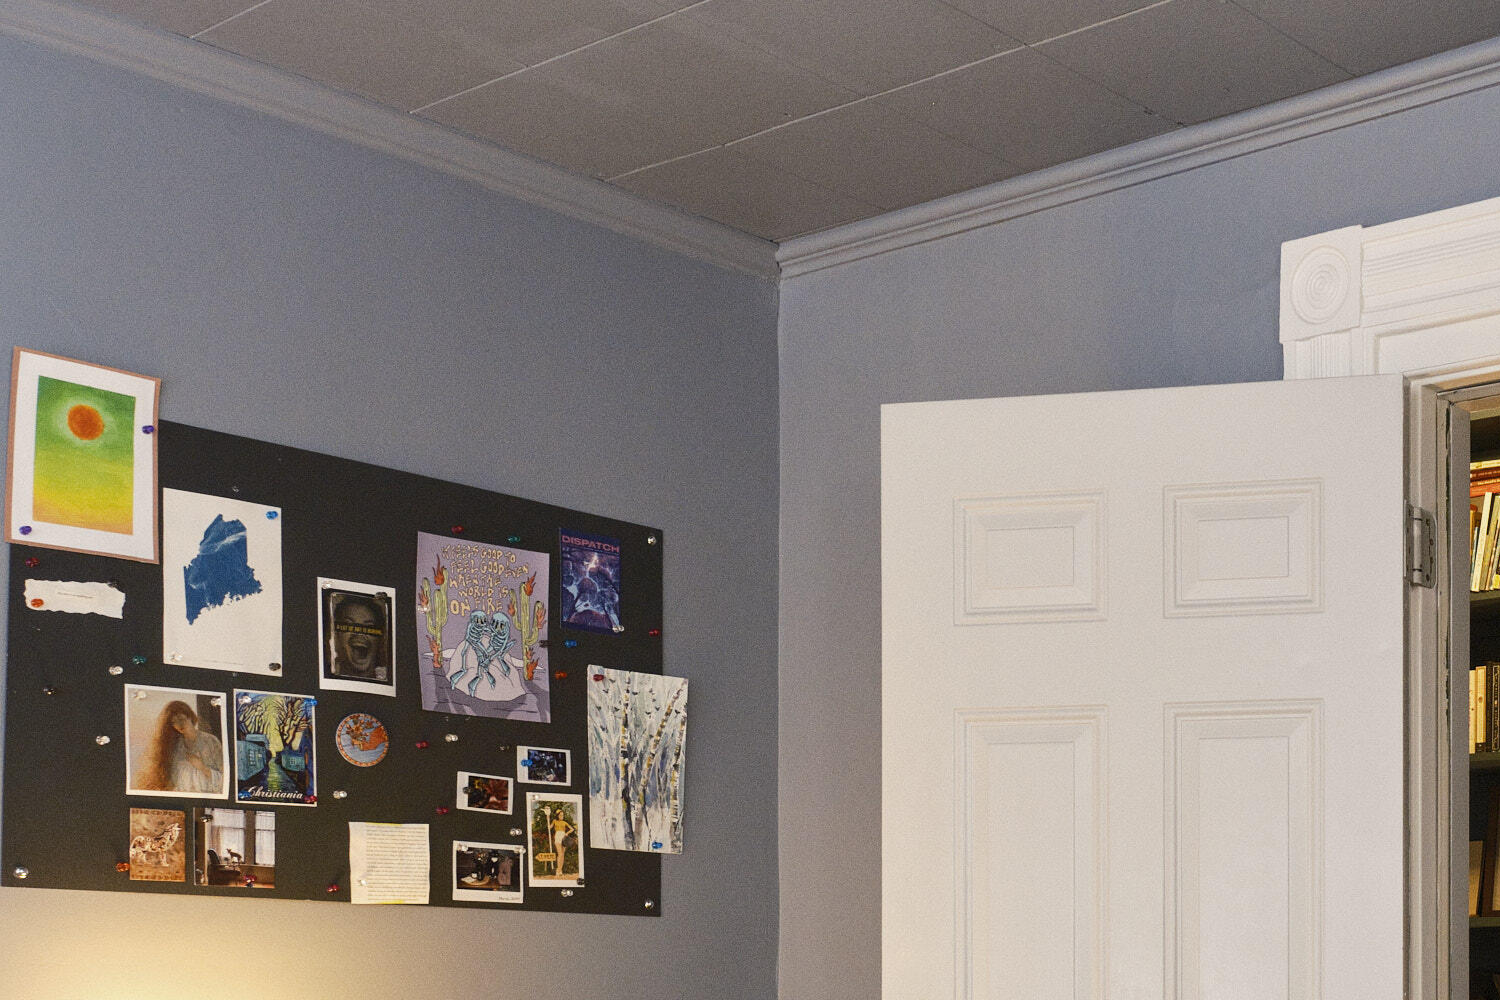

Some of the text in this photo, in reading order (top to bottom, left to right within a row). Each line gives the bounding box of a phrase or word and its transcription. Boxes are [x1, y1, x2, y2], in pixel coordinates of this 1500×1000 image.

[561, 535, 620, 553] DISPATCH
[481, 547, 503, 560] GOOD
[451, 560, 478, 574] FEEL
[480, 561, 505, 575] GOOD
[459, 586, 509, 598] WORLD IS
[450, 598, 503, 616] ON FIRE
[247, 785, 303, 799] Christiania
